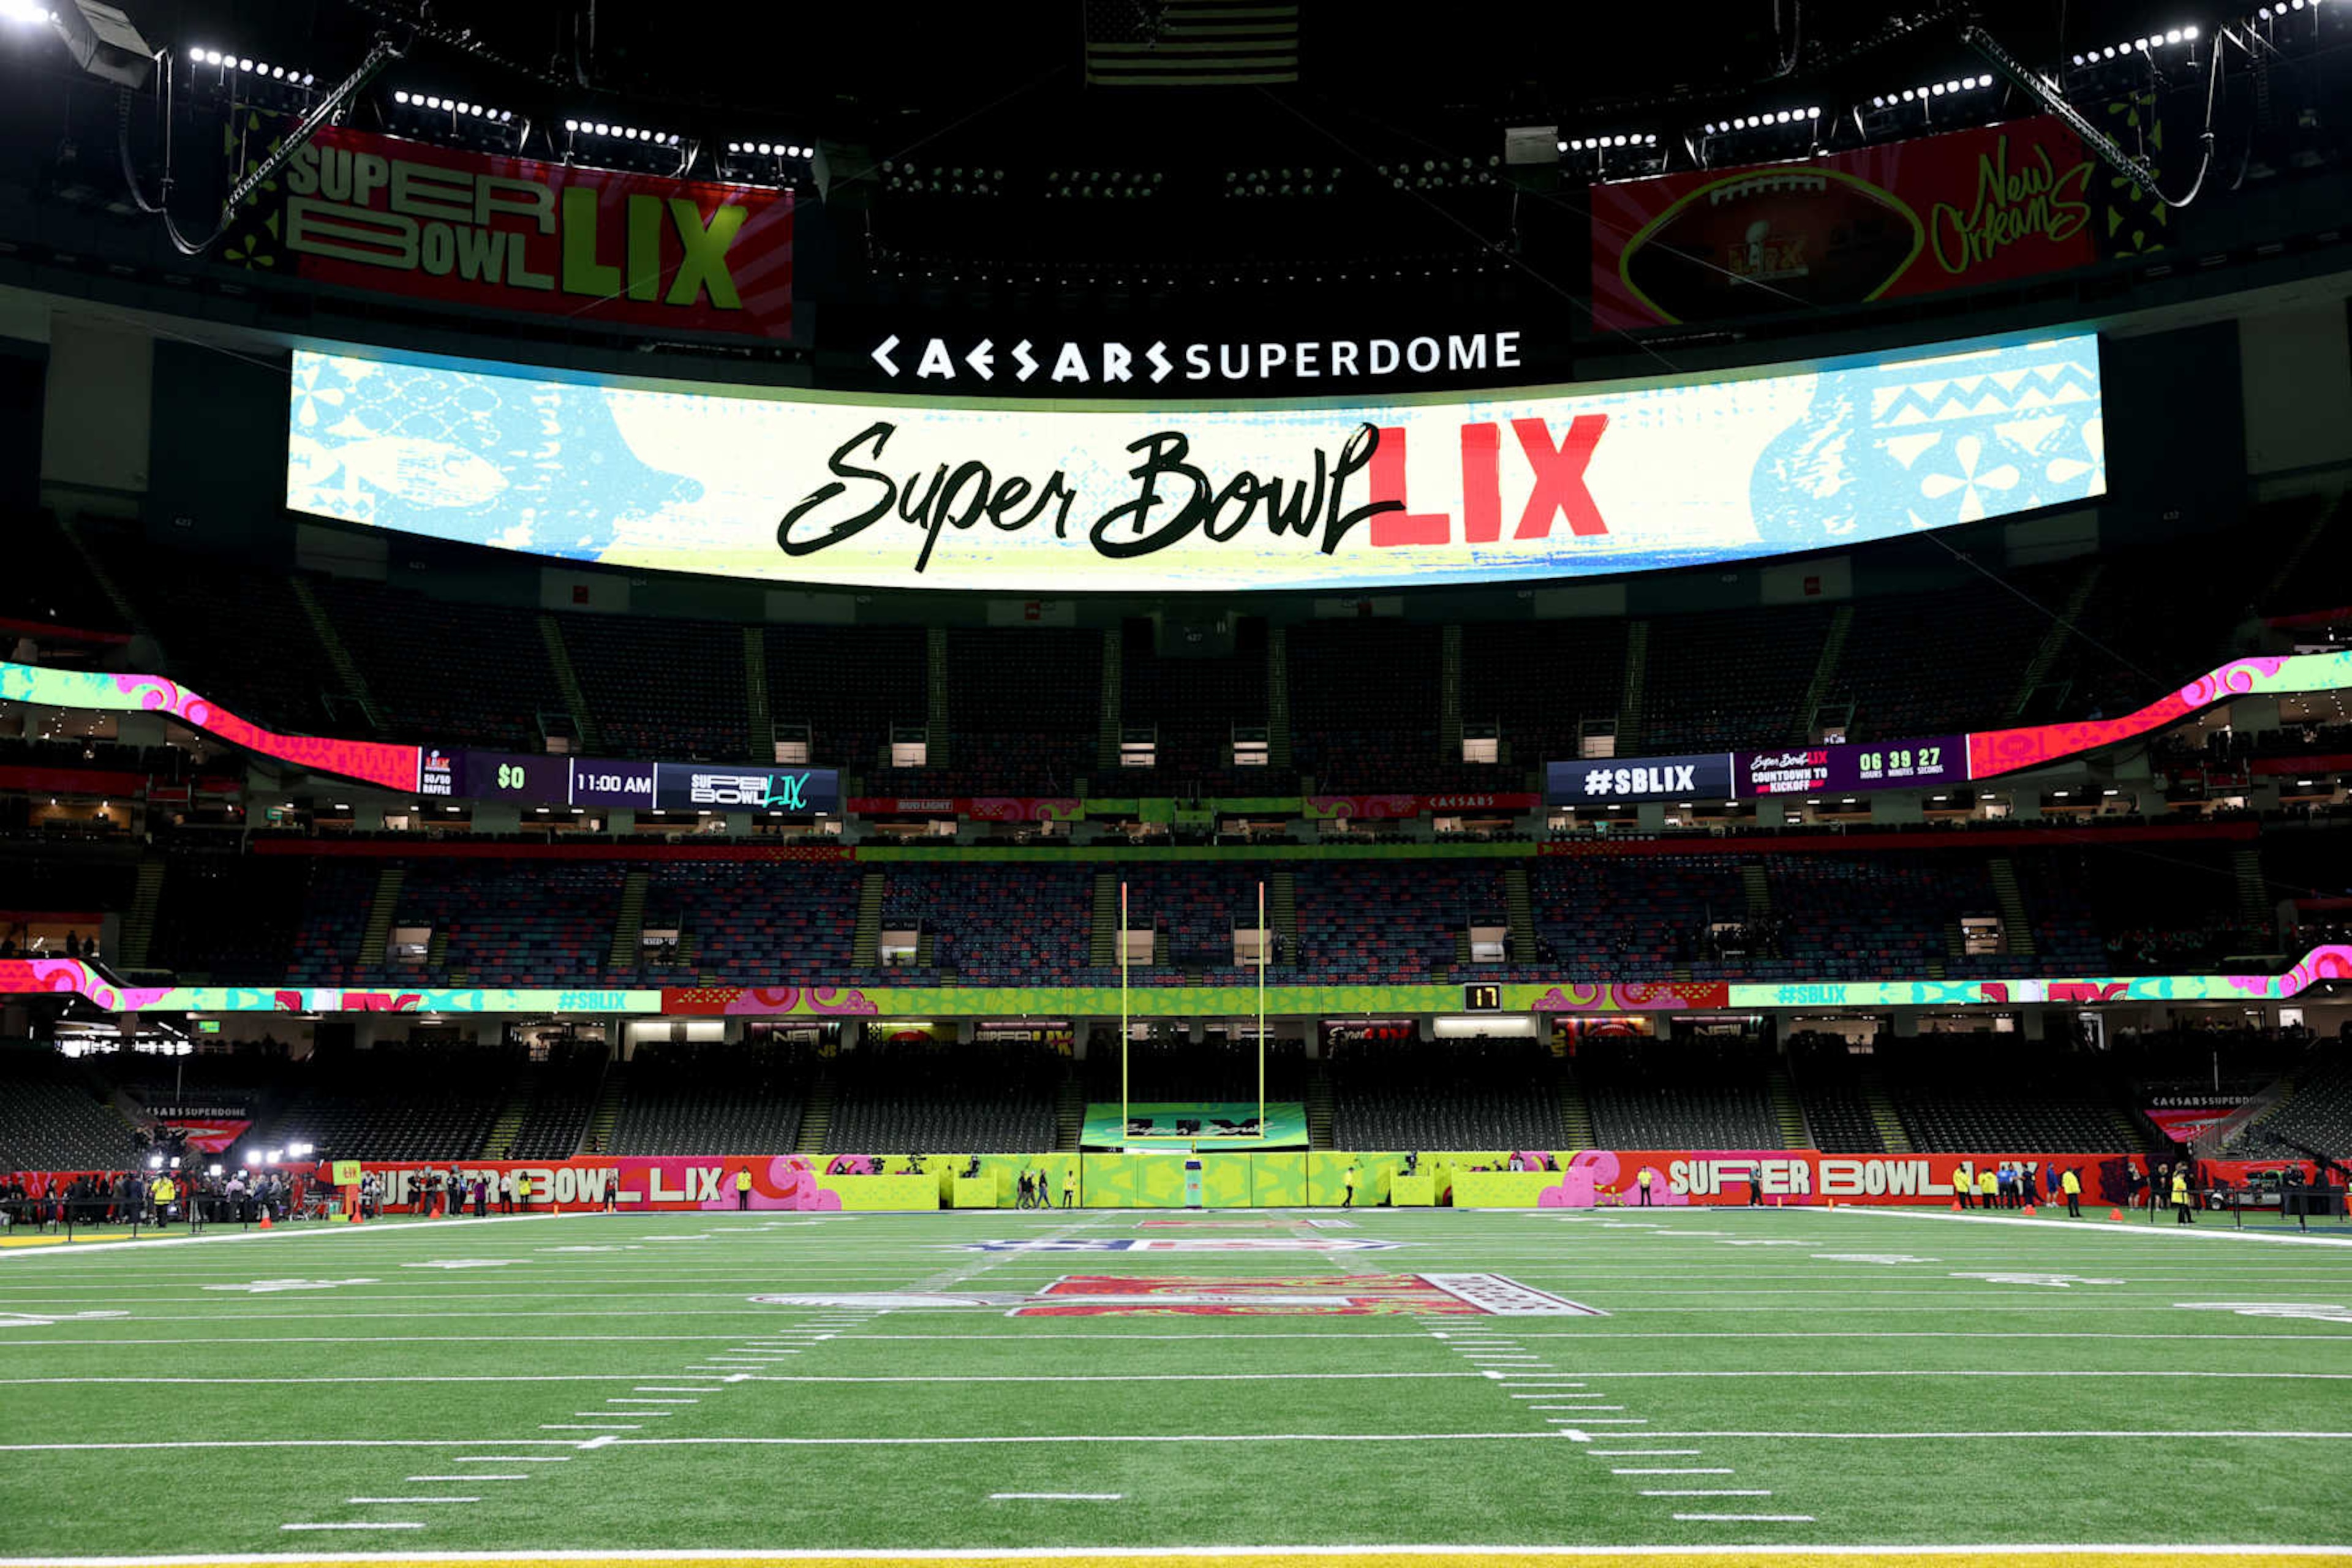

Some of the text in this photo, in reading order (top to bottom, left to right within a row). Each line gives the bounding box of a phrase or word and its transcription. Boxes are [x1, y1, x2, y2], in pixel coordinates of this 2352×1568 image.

[286, 143, 555, 233] SUPER
[1967, 135, 2052, 232] New
[285, 195, 555, 290] BOWL
[562, 186, 748, 310] LIX
[871, 331, 1521, 383] CAESARS SUPERDOME
[777, 413, 1611, 573] Super Bowl LIX
[1807, 751, 1828, 765] LIX
[1860, 747, 1940, 771] 06 39 27
[498, 763, 525, 789] $0
[691, 774, 769, 789] SUPER
[1584, 765, 1695, 795] #SBLIX
[1752, 767, 1828, 783] COUNTDOWN TO
[1860, 770, 1883, 780] HOURS
[1917, 764, 1944, 775] SECONDS
[578, 774, 651, 793] 11:00 AM
[763, 772, 810, 810] LIX
[1770, 780, 1810, 793] KICKOFF
[690, 788, 769, 805] BOWL
[1429, 795, 1494, 807] CAESARS
[558, 992, 627, 1010] #SBLIX
[1475, 987, 1498, 1006] 17
[1778, 984, 1847, 1005] #SBLIX
[186, 1107, 246, 1117] SUPERDOME
[2152, 1096, 2207, 1107] CAESARS
[511, 1167, 643, 1204] BOWL
[650, 1167, 723, 1202] LIX
[1669, 1159, 1812, 1195] SUPER
[1820, 1158, 1954, 1196] BOWL
